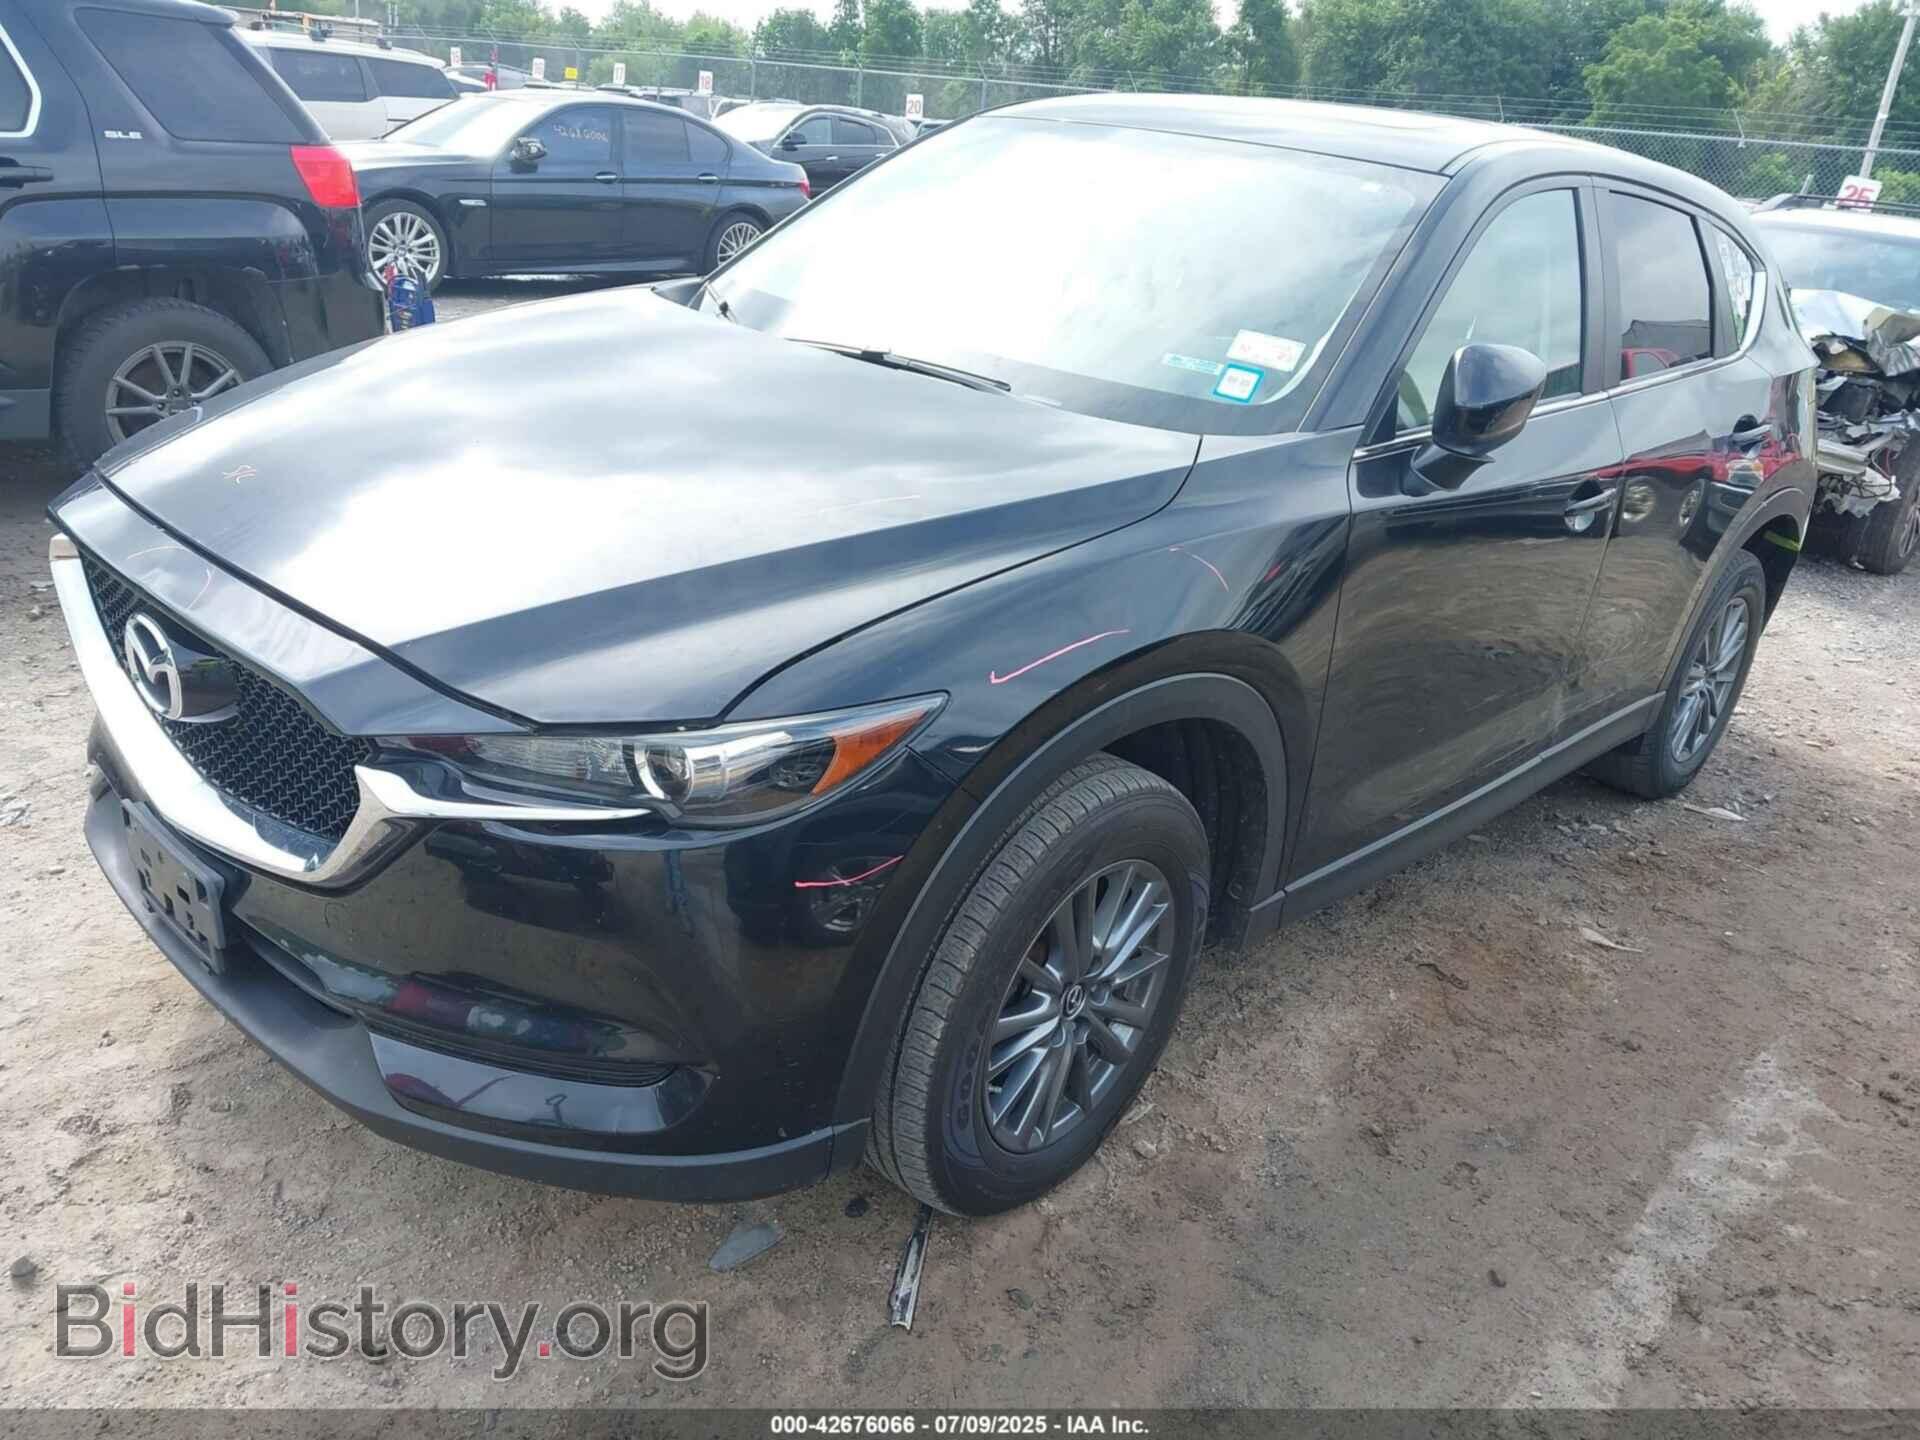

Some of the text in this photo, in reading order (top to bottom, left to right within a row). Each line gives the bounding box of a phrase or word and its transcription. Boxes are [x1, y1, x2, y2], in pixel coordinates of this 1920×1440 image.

[908, 100, 921, 113] 20
[104, 130, 142, 139] SLE
[1838, 185, 1874, 206] 25
